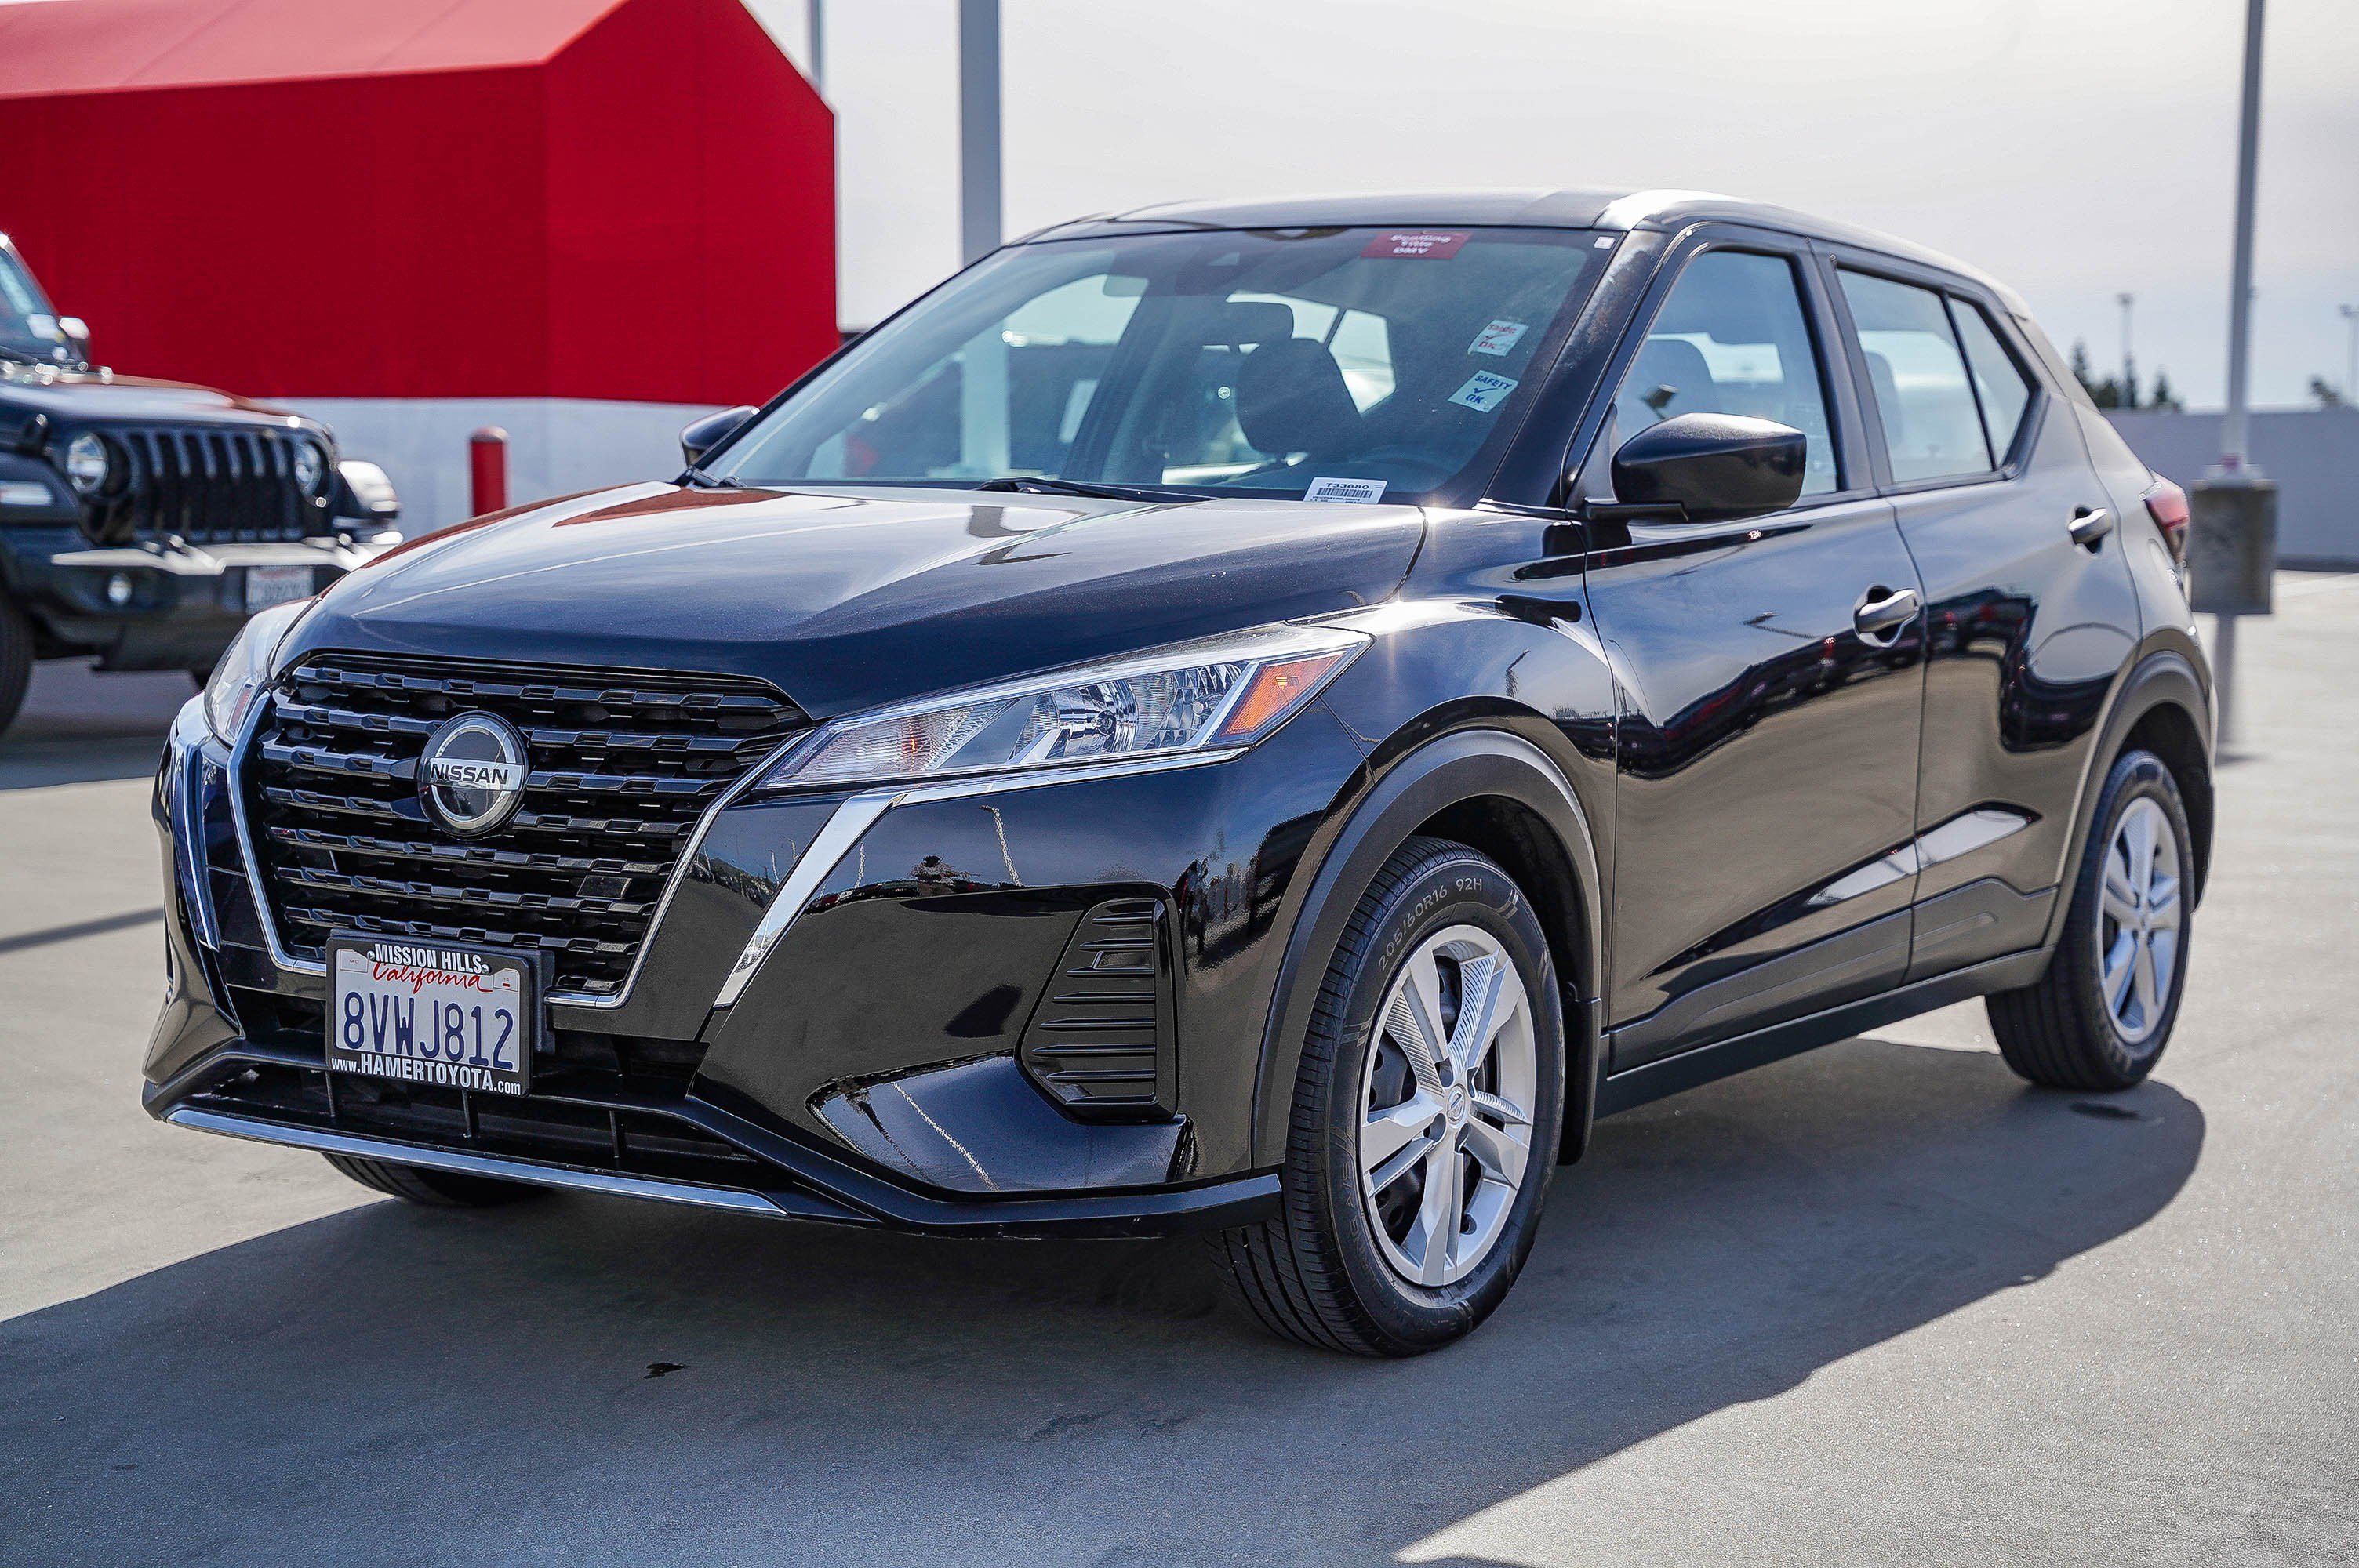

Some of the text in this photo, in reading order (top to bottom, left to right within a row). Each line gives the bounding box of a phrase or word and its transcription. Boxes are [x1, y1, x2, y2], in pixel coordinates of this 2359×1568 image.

[1474, 375, 1513, 390] SAFETY
[1465, 394, 1485, 404] OK
[431, 763, 508, 785] NISSAN
[1378, 877, 1483, 973] 205/60R16 92H
[374, 943, 482, 974] MISSION HILLS
[373, 961, 493, 994] California
[343, 991, 514, 1070] 8VWJ812
[331, 1054, 521, 1096] www.HAMERTOYOTA.com
